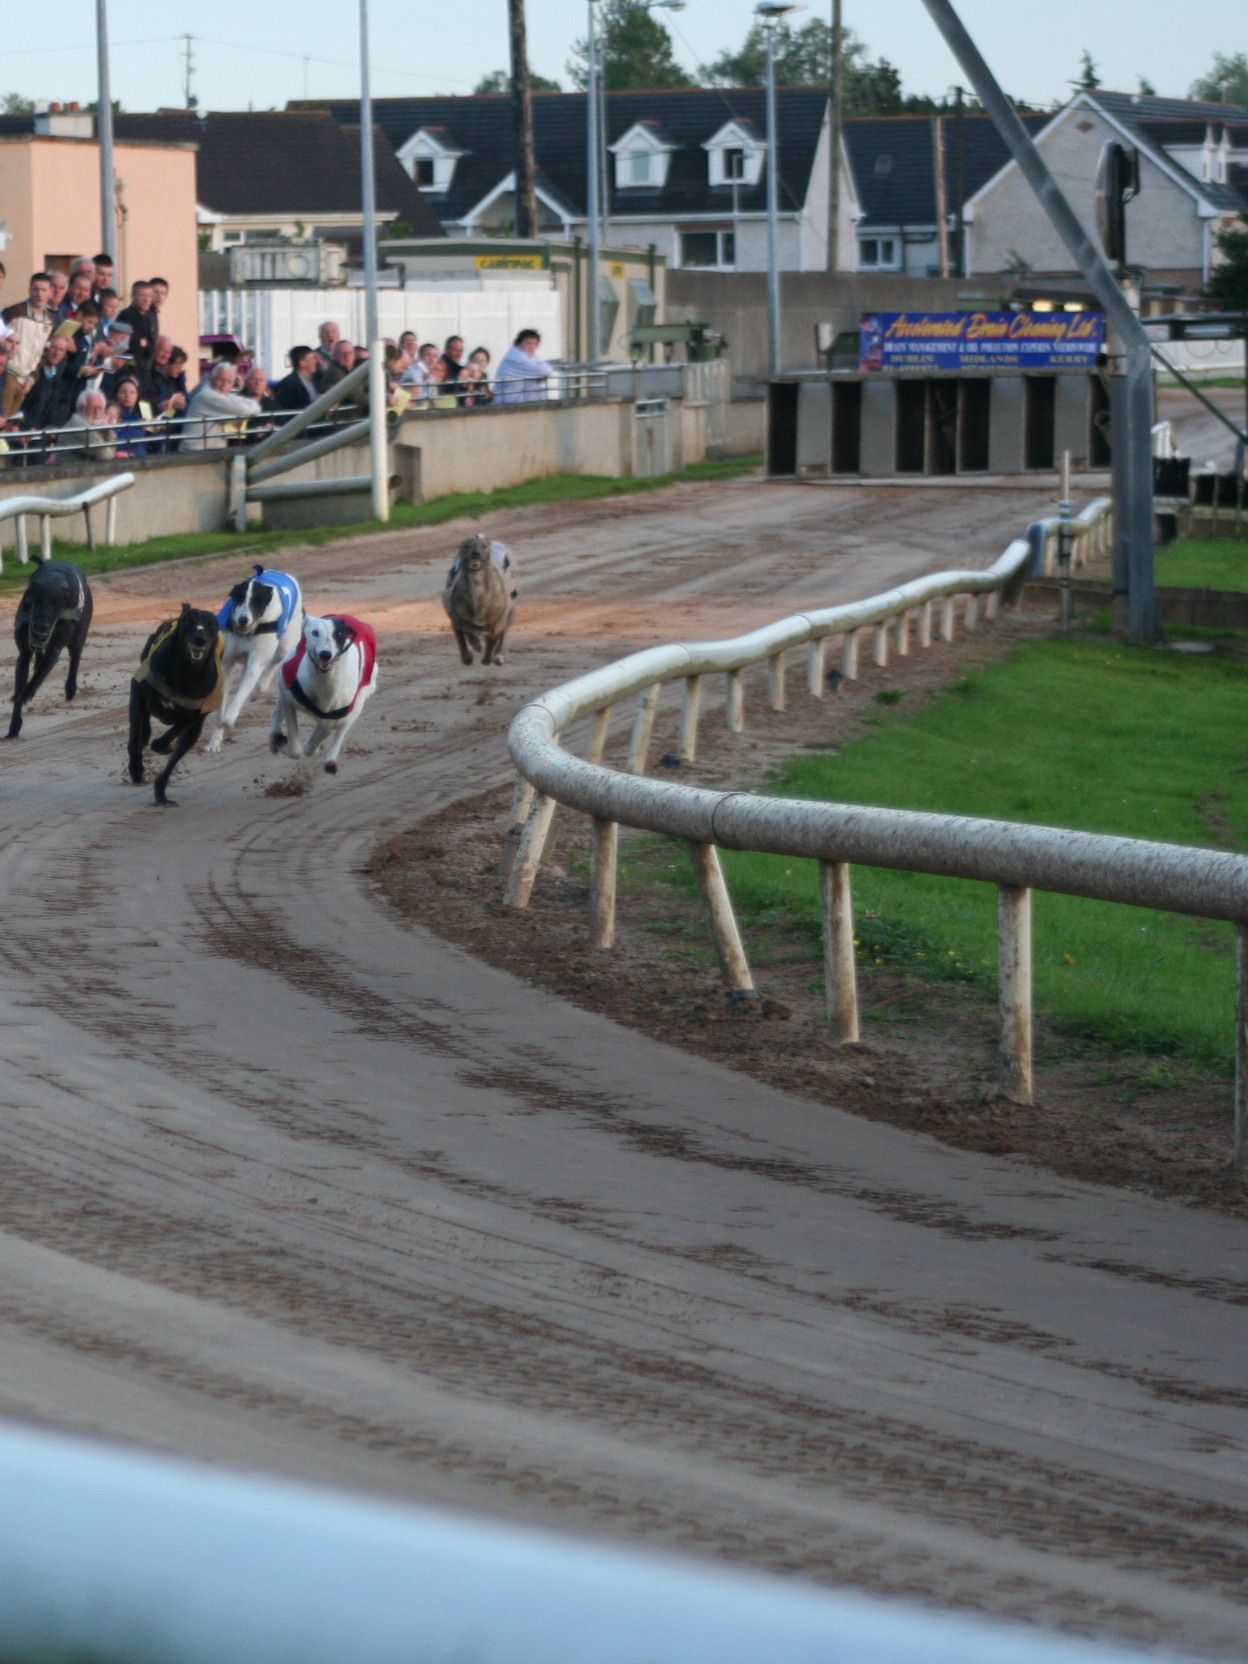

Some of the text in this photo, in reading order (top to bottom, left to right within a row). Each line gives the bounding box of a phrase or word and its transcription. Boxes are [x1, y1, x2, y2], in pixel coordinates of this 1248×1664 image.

[884, 313, 1098, 344] Accelerated Drain Cleaning Ltd.
